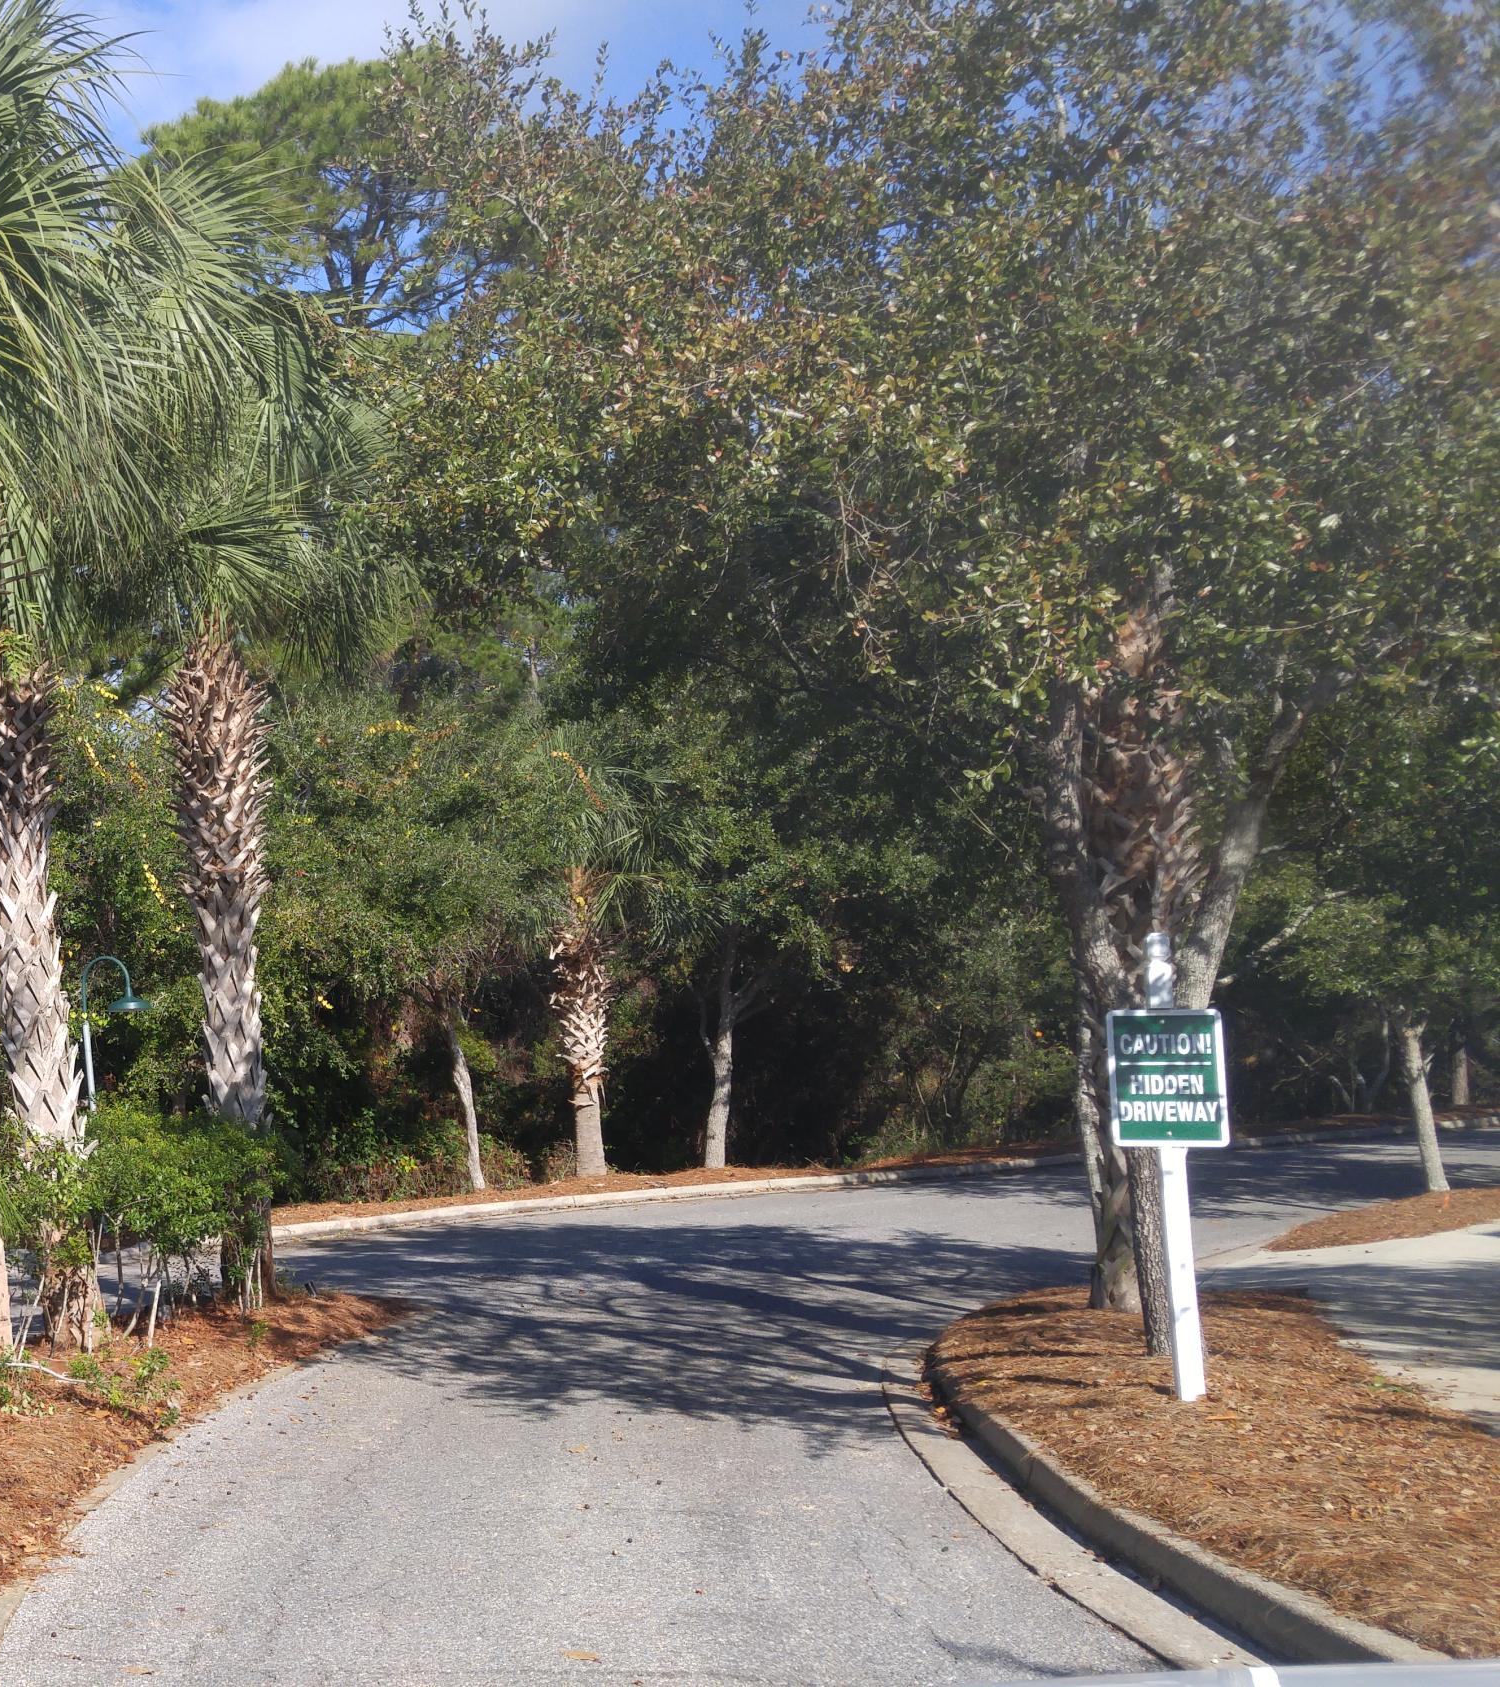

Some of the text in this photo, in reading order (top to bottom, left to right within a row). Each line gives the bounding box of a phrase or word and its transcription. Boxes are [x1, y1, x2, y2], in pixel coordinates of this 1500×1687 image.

[1120, 1033, 1212, 1055] CAUTION!
[1130, 1074, 1204, 1095] HIDDEN
[1119, 1101, 1218, 1122] DRIVEWAY
